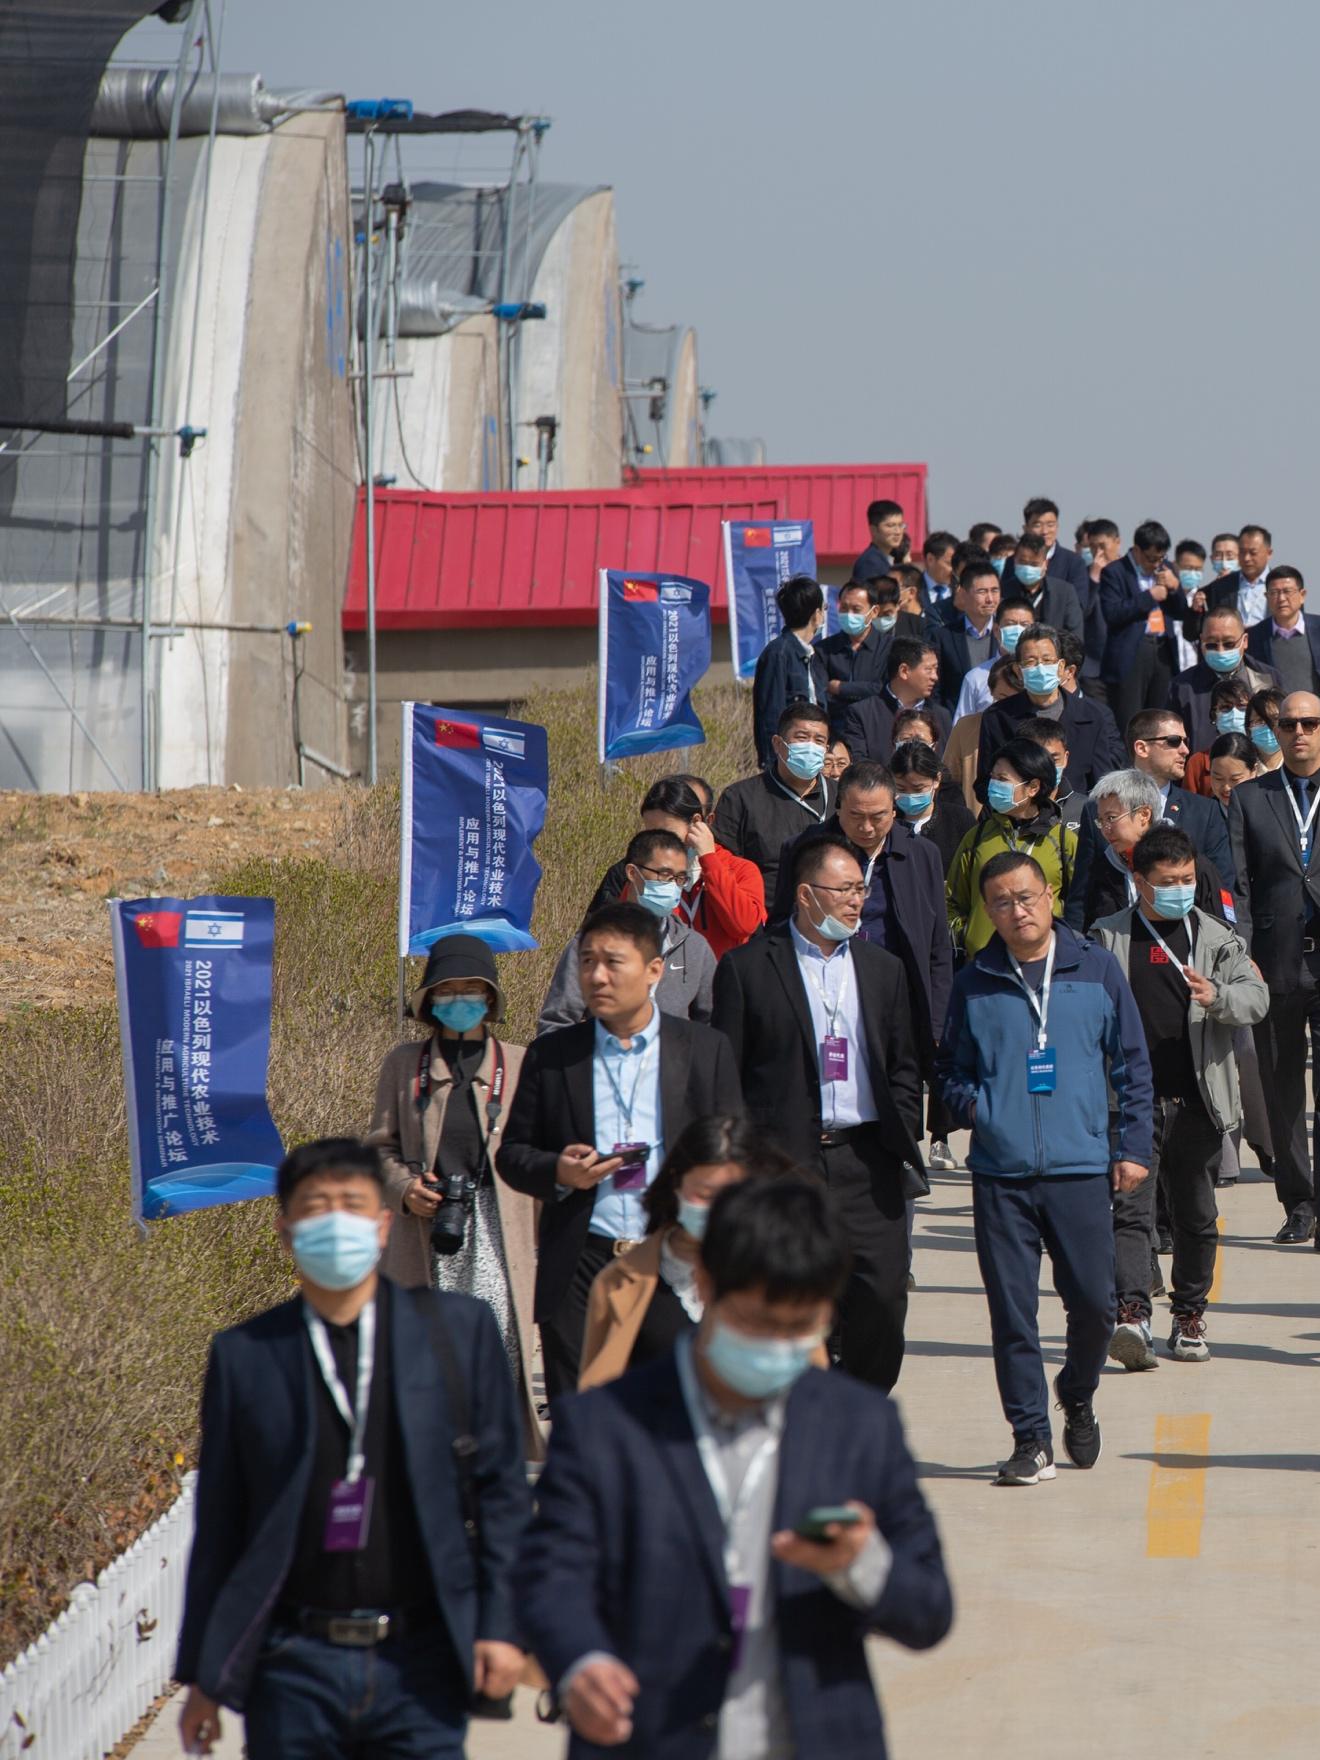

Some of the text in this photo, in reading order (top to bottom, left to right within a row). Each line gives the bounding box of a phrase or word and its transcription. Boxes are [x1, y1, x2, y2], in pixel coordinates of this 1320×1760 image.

[459, 817, 481, 916] 应用与推广论坛
[487, 760, 507, 908] 2021以色列现代农业技术
[160, 1038, 189, 1163] 应用与推广论坛
[181, 960, 199, 1147] 2021 ISRAELI MODERN AGRICULTURE TECHNOLOGY
[191, 960, 221, 1146] 2021以色列现代农业技术
